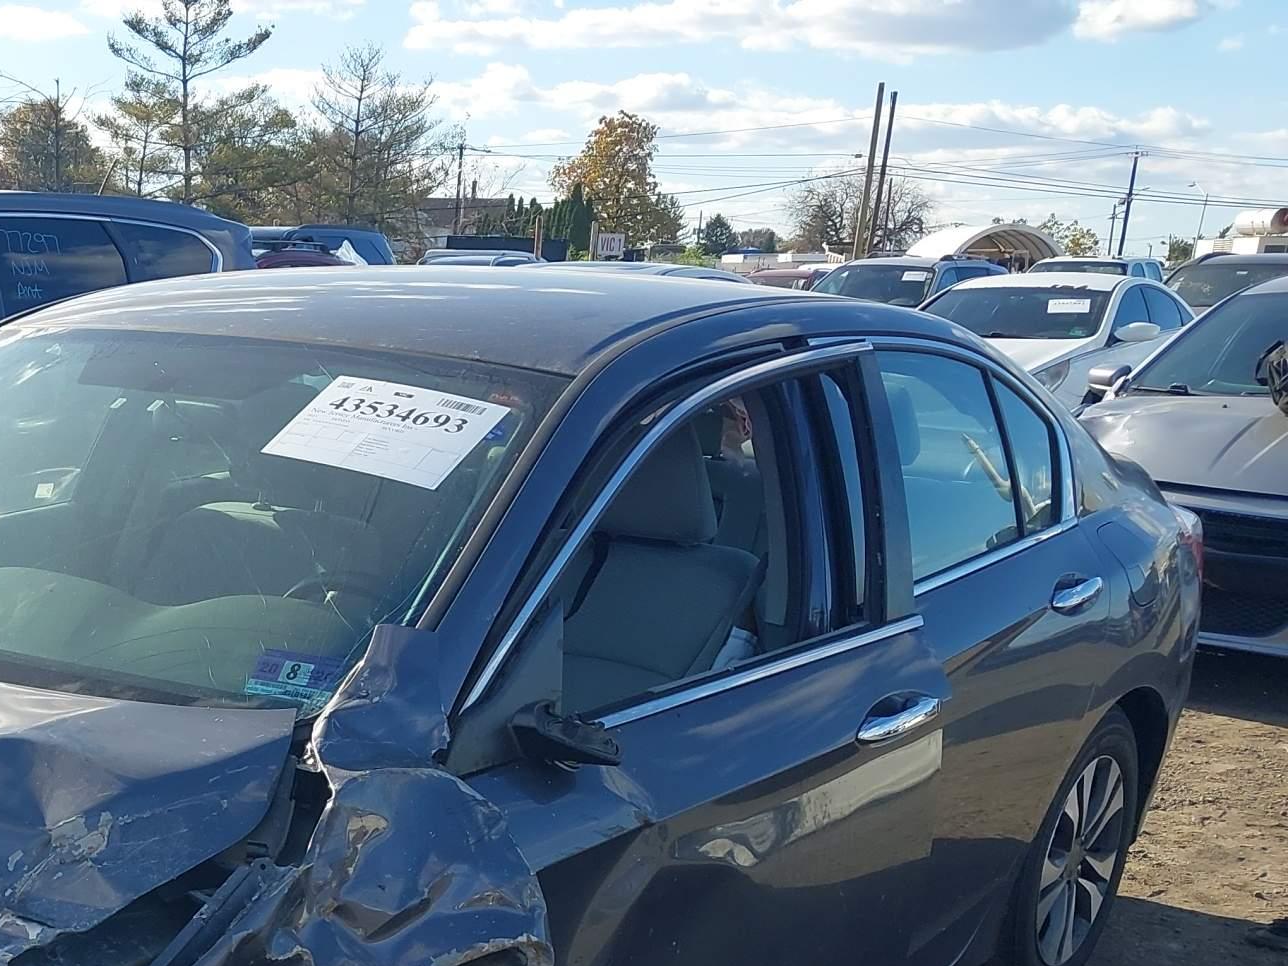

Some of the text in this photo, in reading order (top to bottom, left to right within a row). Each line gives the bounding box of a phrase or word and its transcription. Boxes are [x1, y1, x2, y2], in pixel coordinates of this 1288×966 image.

[601, 237, 616, 252] VIC
[329, 396, 468, 433] 43534693
[285, 662, 302, 681] 8
